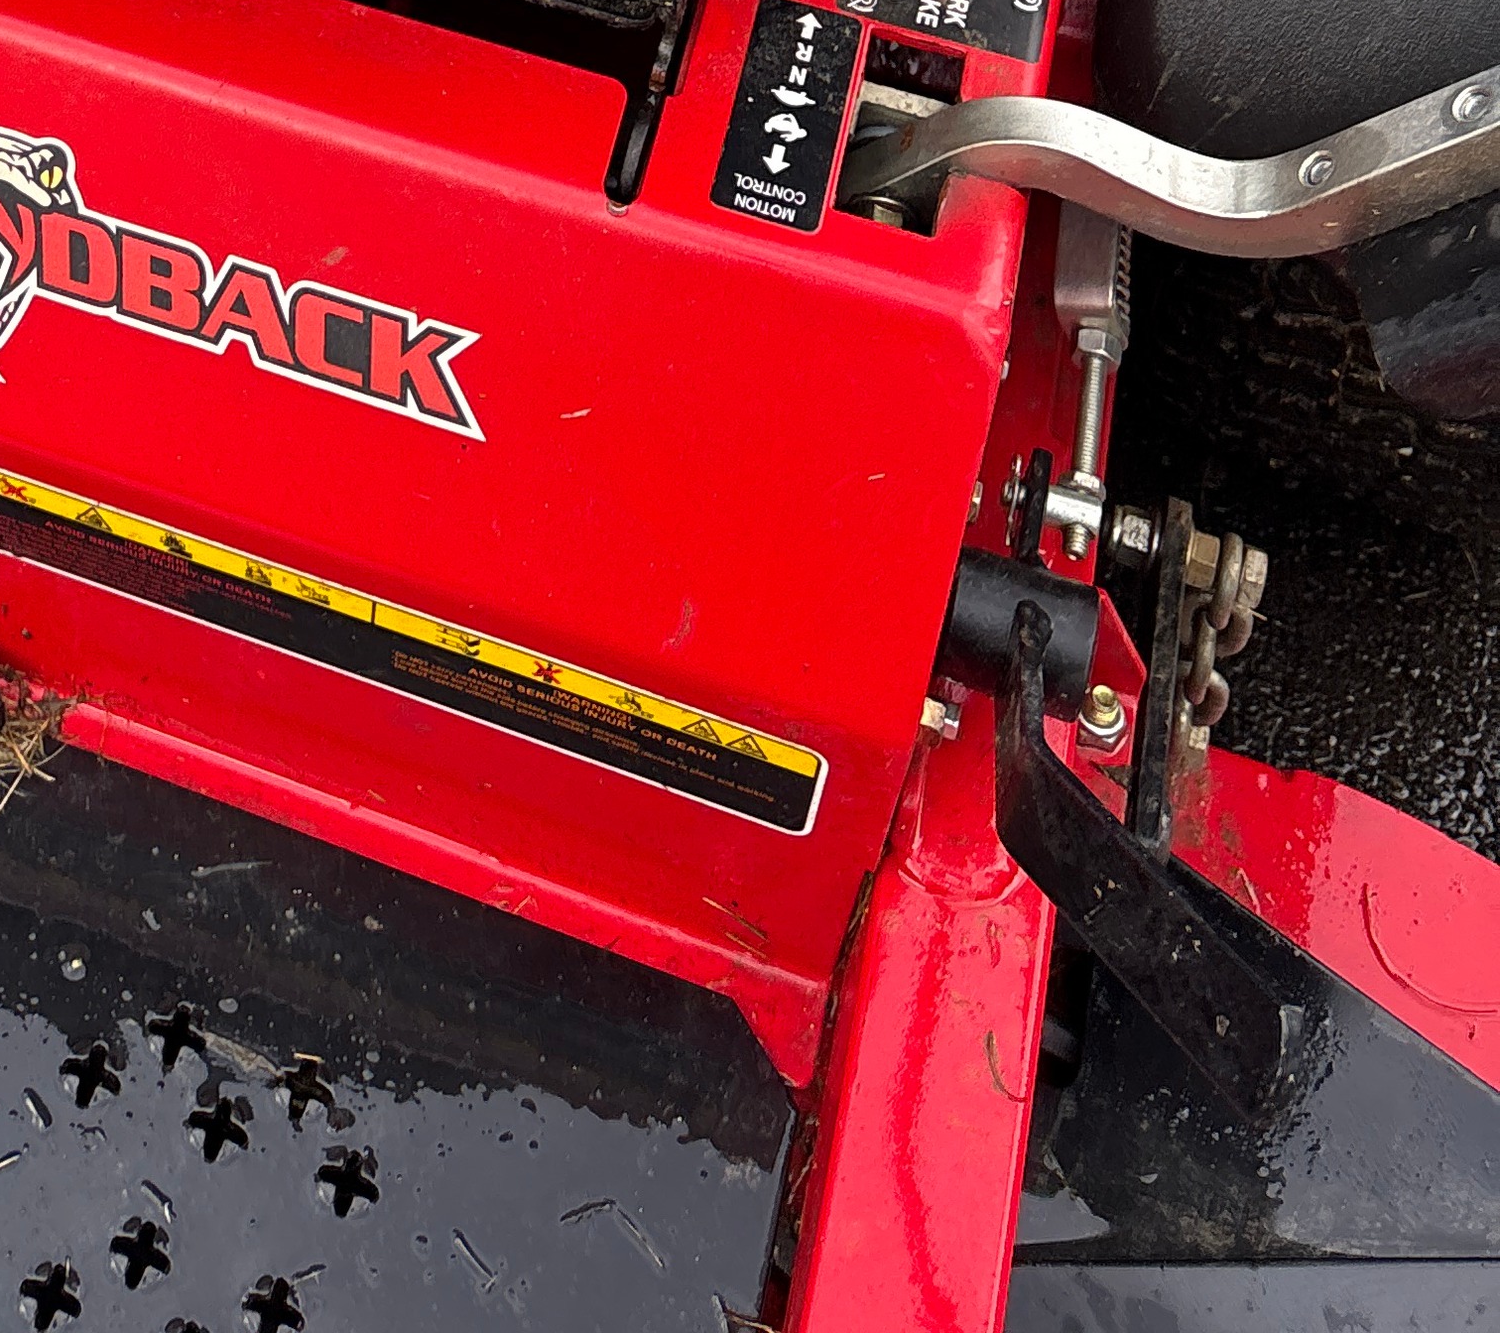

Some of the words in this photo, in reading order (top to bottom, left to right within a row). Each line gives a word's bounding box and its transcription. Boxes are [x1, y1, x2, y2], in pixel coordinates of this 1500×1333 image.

[795, 42, 814, 63] R
[788, 65, 807, 86] N
[734, 173, 806, 205] CONTROL
[734, 193, 796, 222] MOTION
[44, 518, 85, 540] AVOID
[88, 534, 147, 561] SERIOUS
[150, 555, 198, 579] INJURY
[201, 573, 221, 587] OR
[225, 581, 272, 605] DEATH
[467, 665, 513, 689] AVOID
[515, 683, 580, 713] SERIOUS
[582, 707, 637, 733] INJURY
[639, 727, 663, 742] OR
[665, 736, 718, 762] DEATH
